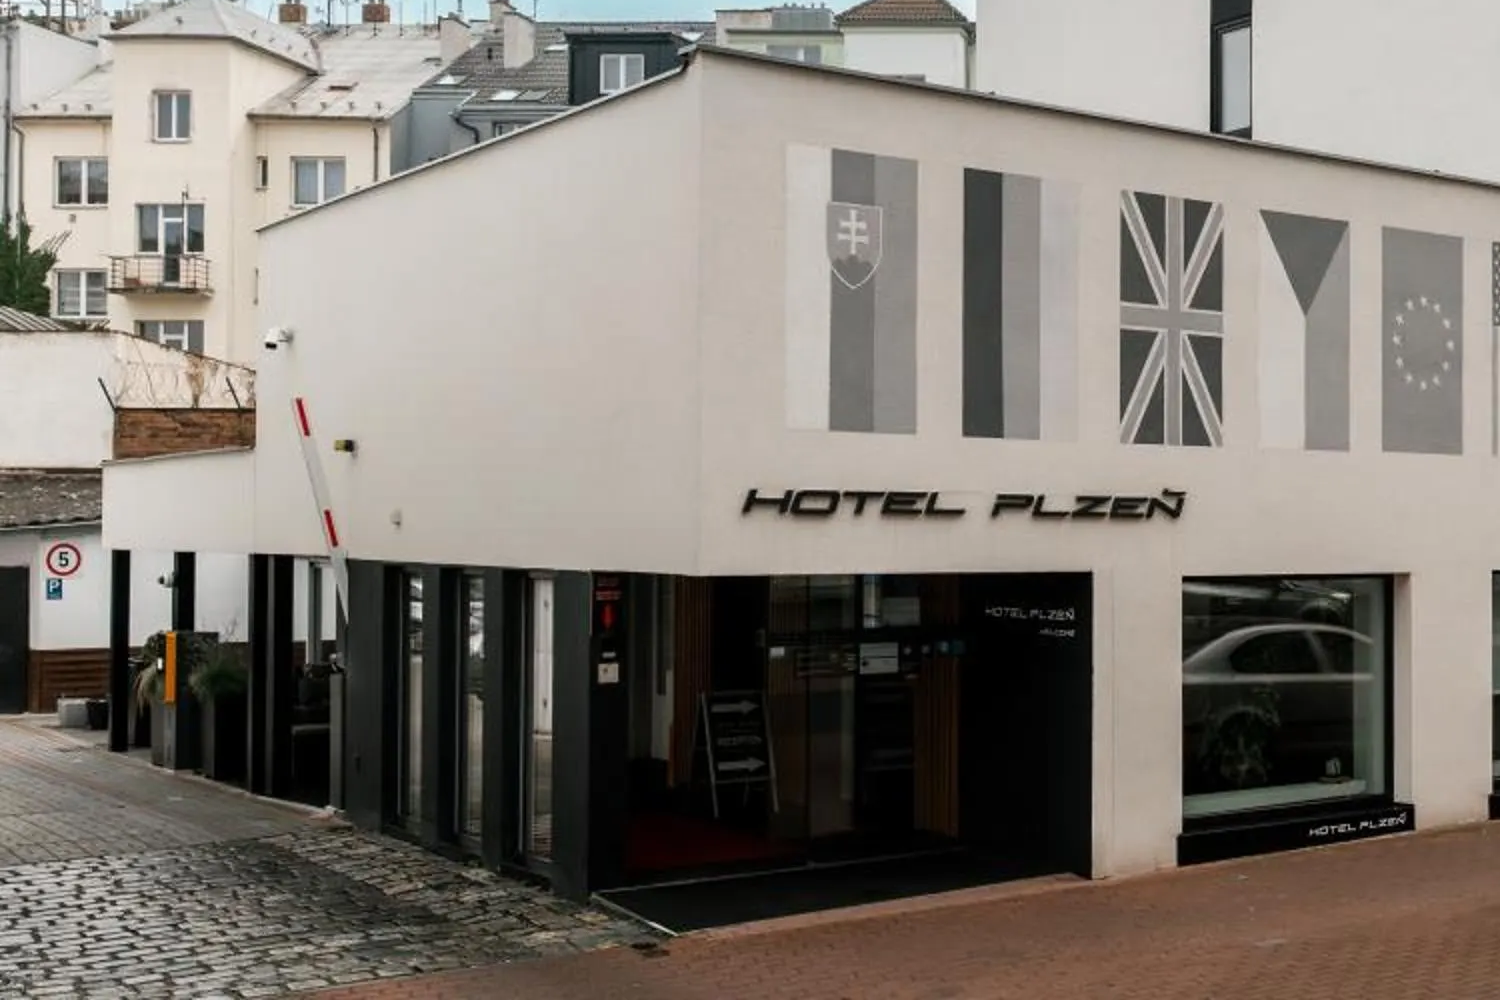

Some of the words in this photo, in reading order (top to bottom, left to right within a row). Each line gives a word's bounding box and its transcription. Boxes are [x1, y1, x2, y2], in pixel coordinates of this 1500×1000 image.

[741, 488, 966, 520] HOTEL
[990, 488, 1188, 521] PLZEŇ
[58, 551, 69, 567] 5
[985, 606, 1028, 619] HOTEL
[1308, 823, 1357, 836] HOTEL
